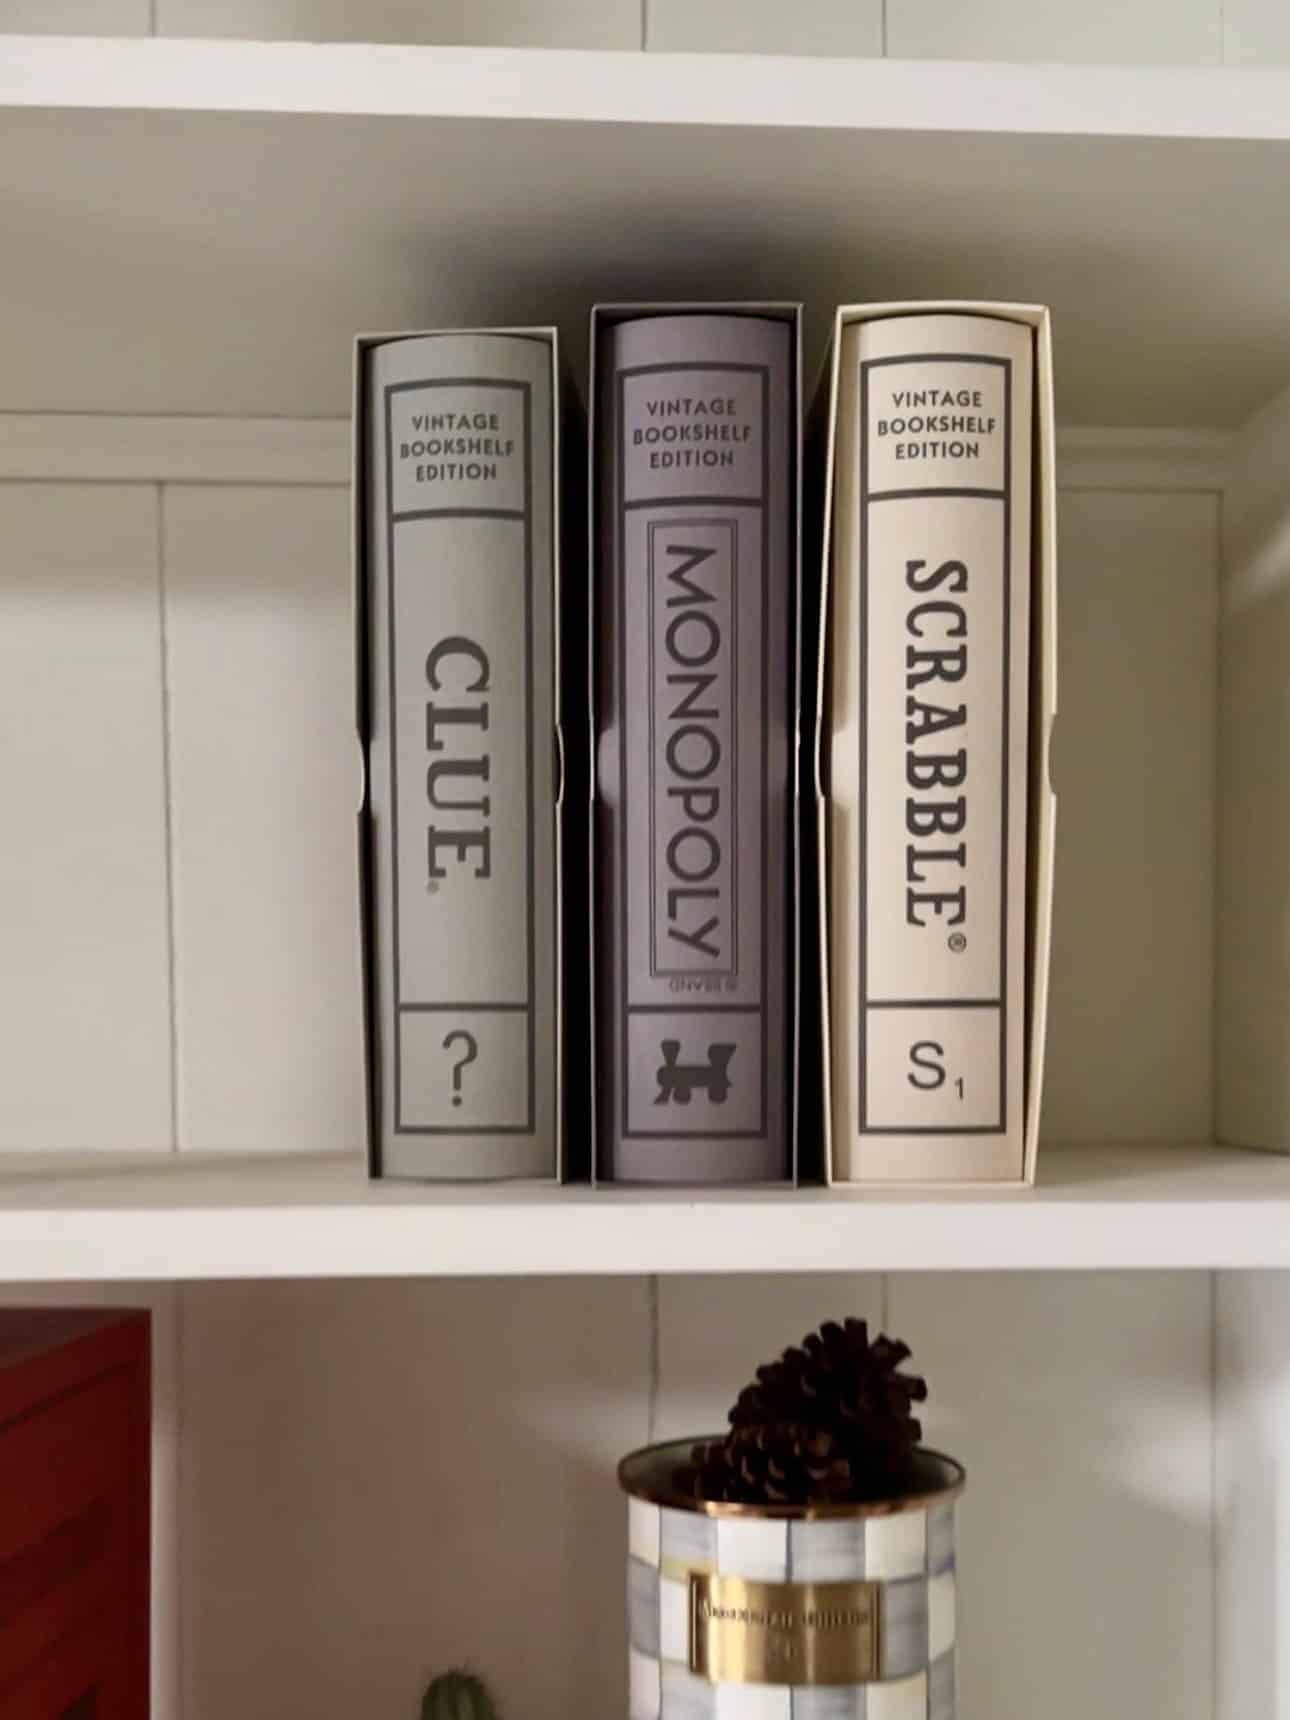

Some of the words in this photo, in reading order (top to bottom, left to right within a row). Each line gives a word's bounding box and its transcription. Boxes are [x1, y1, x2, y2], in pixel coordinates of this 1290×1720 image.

[646, 396, 737, 416] VINTAGE
[892, 390, 983, 408] VINTAGE
[411, 412, 498, 431] VINTAGE
[878, 416, 997, 435] BOOKSHELF
[633, 424, 750, 445] BOOKSHELF
[400, 438, 514, 458] BOOKSHELF
[896, 441, 980, 459] EDITION
[650, 449, 734, 470] EDITION
[416, 463, 496, 481] EDITION
[666, 545, 721, 959] MONOPOLY
